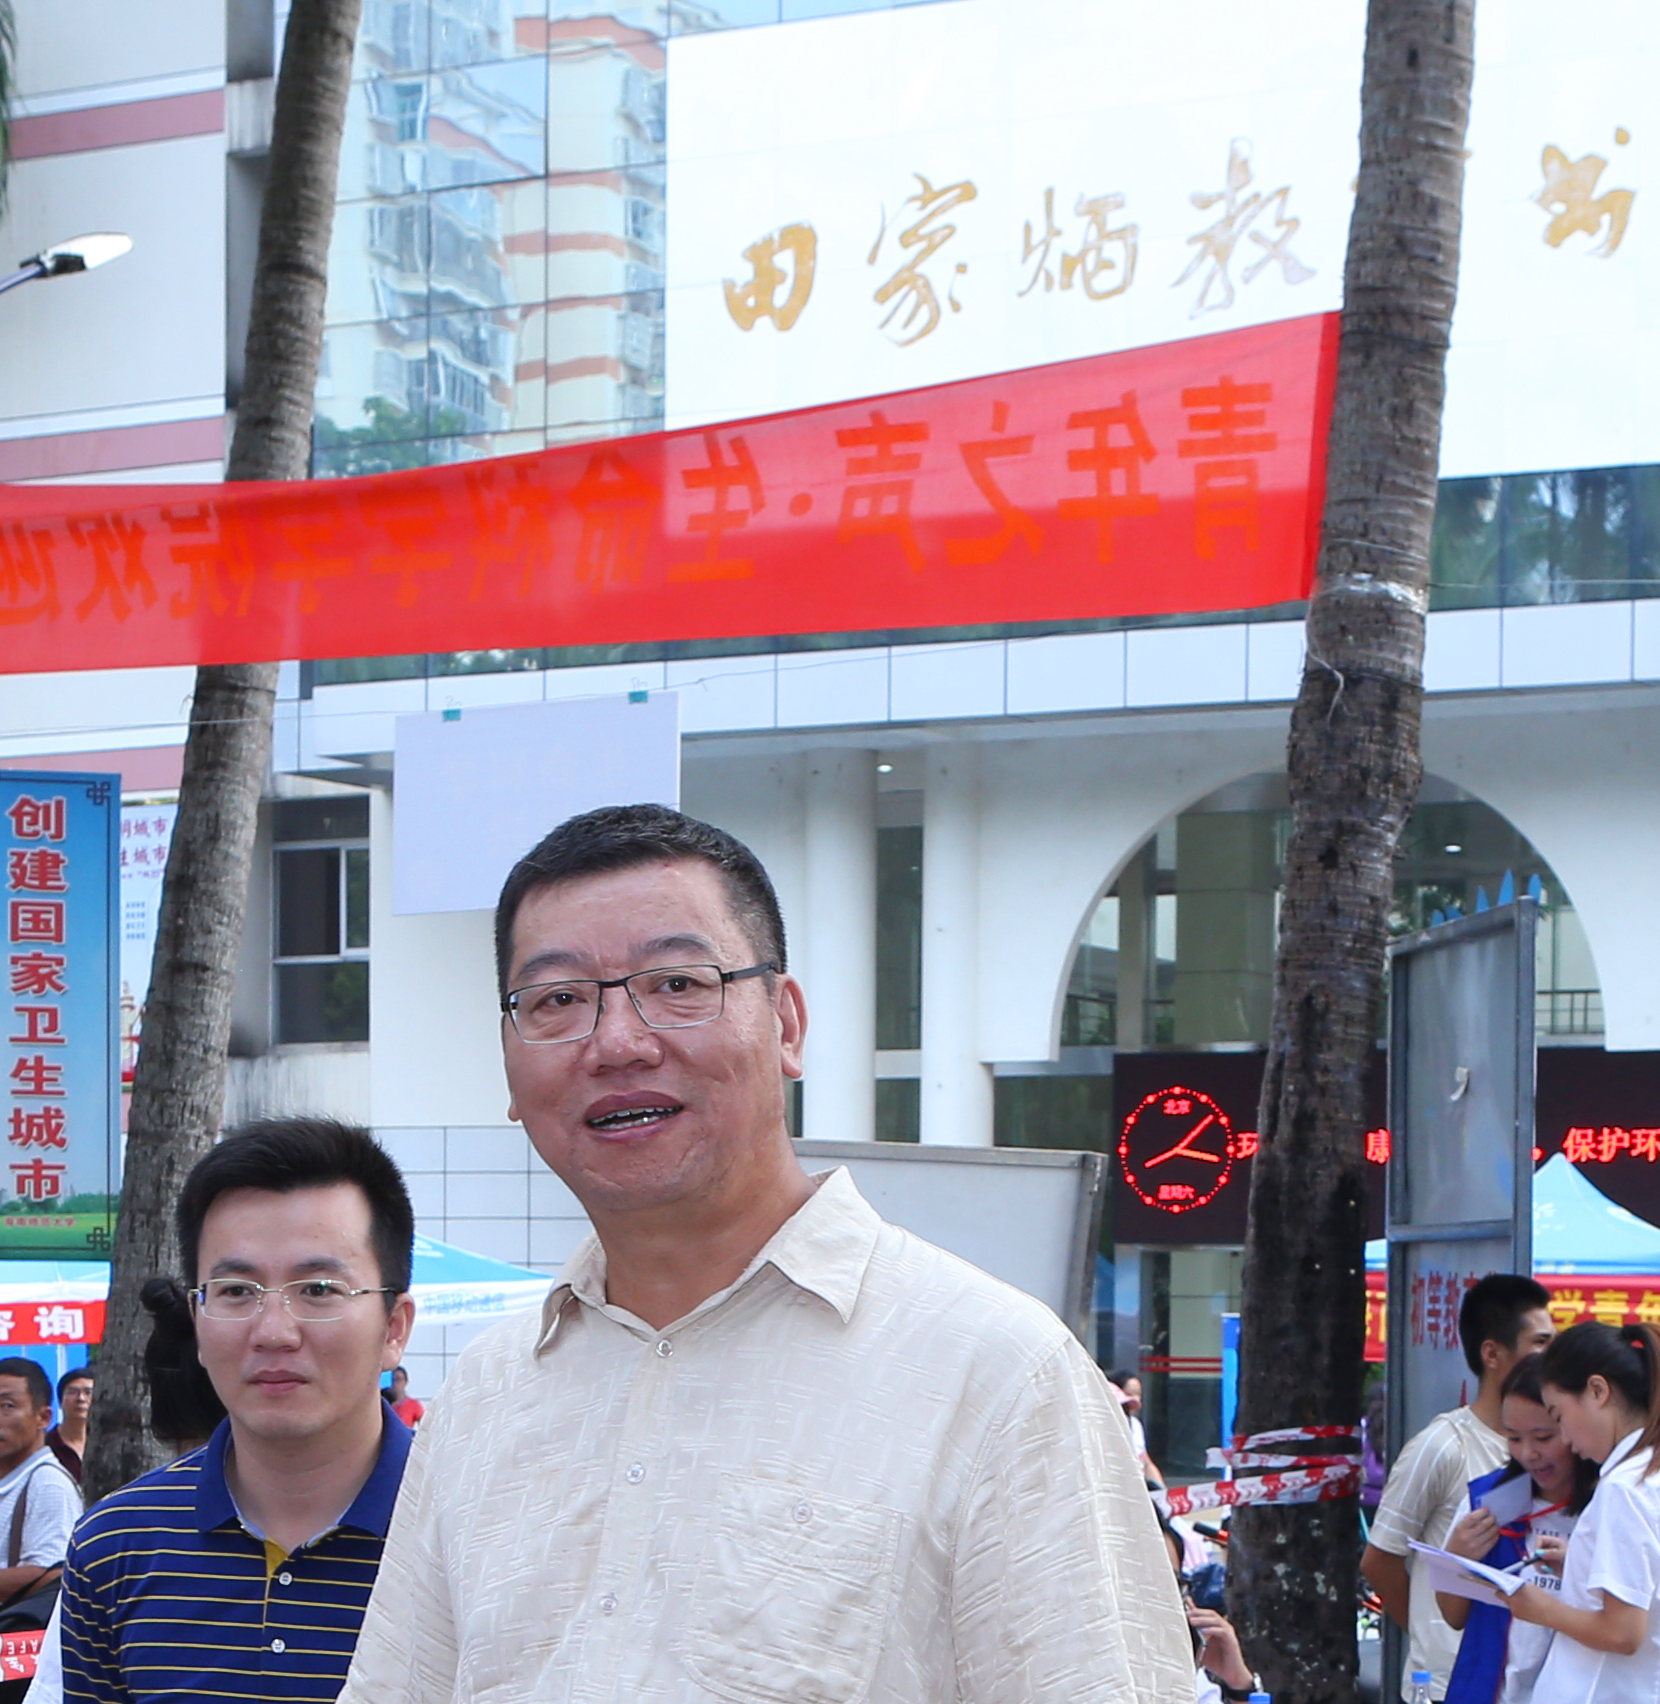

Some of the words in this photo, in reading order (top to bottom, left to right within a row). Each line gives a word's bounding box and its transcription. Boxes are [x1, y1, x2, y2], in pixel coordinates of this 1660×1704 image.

[7, 795, 68, 1201] 创建国家卫生城市
